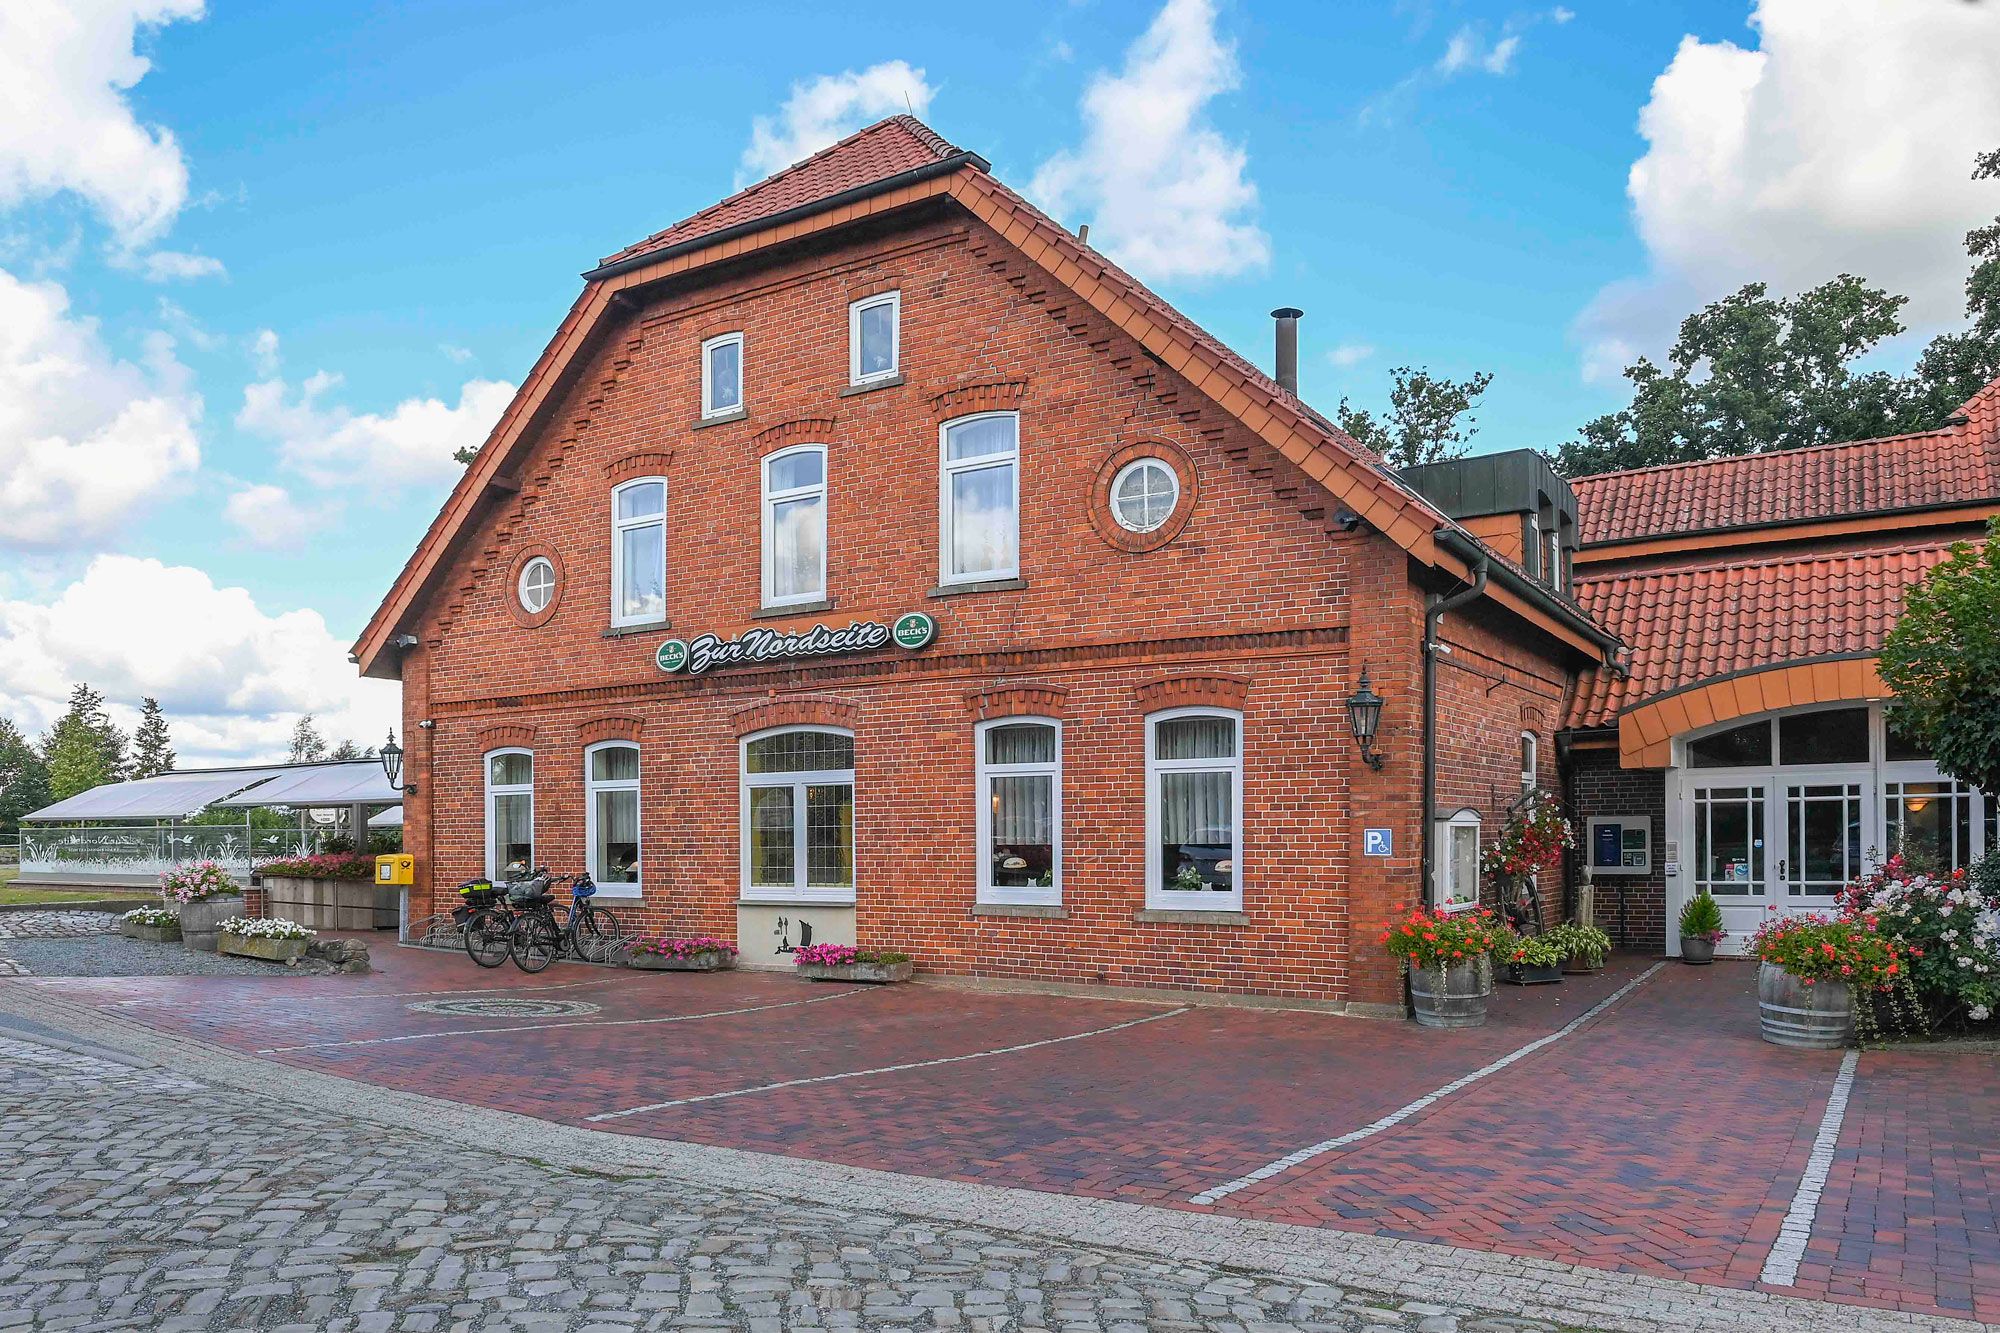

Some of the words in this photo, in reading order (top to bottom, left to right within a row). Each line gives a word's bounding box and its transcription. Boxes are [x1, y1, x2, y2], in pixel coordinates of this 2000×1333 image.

[897, 626, 928, 637] BECK'S
[691, 637, 744, 671] Zur
[742, 624, 886, 658] Nordseite
[1367, 831, 1382, 853] P
